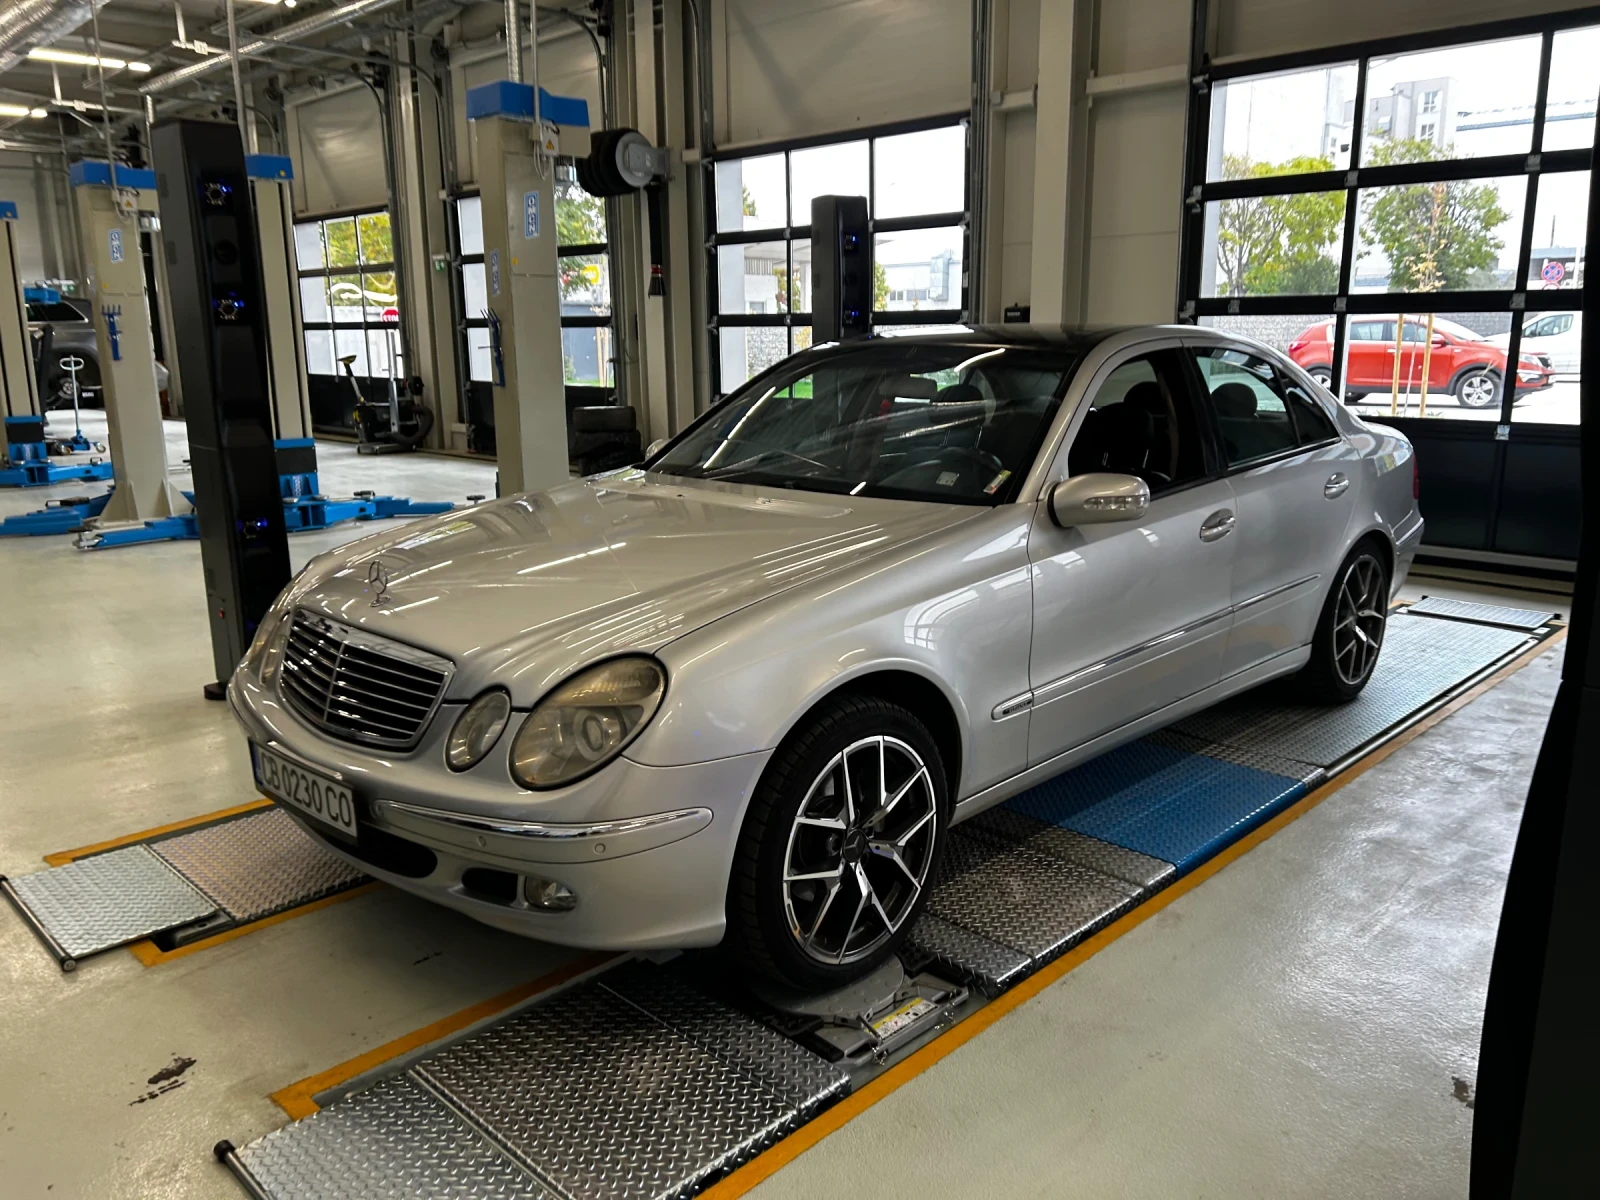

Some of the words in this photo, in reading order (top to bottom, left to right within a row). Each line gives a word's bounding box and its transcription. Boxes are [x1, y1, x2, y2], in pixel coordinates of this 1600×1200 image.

[528, 196, 536, 234] OMCN
[261, 752, 280, 790] CB
[282, 764, 323, 814] 0230
[325, 785, 352, 828] CO
